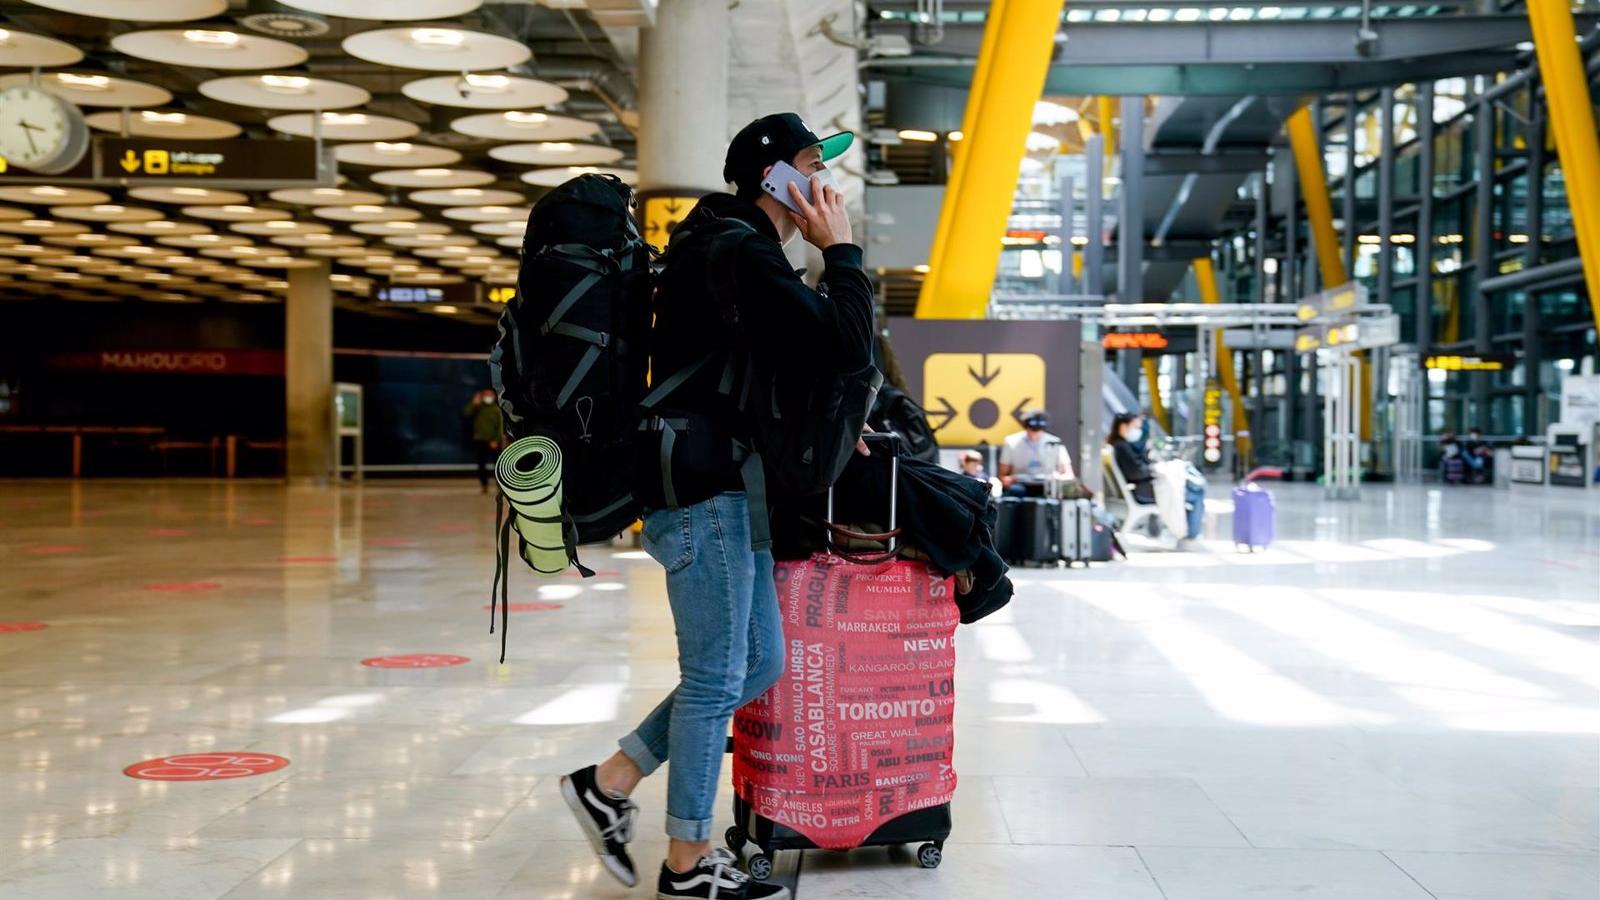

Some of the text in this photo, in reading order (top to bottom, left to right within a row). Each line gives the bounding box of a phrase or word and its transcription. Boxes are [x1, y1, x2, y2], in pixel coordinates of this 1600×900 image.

[855, 573, 904, 583] PROVENCE
[865, 584, 912, 594] MUMBAI
[864, 609, 900, 621] SAN
[837, 621, 901, 633] MARRAKECH
[906, 621, 944, 630] GOLDEN
[903, 637, 947, 652] NEW
[849, 663, 916, 673] KANGAROO
[825, 654, 837, 715] MOHAMMED
[793, 683, 804, 722] PAULO
[807, 642, 828, 772] CASABLANCA
[837, 699, 935, 721] TORONTO
[851, 727, 922, 741] GREAT WALL
[776, 751, 805, 763] KONG
[828, 734, 838, 772] SQUARE
[876, 751, 948, 769] ABU SIMBEL
[813, 772, 871, 789] PARIS
[760, 794, 823, 813] LOS ANGELES
[759, 804, 828, 829] CAIRO
[831, 815, 861, 829] PETRA
